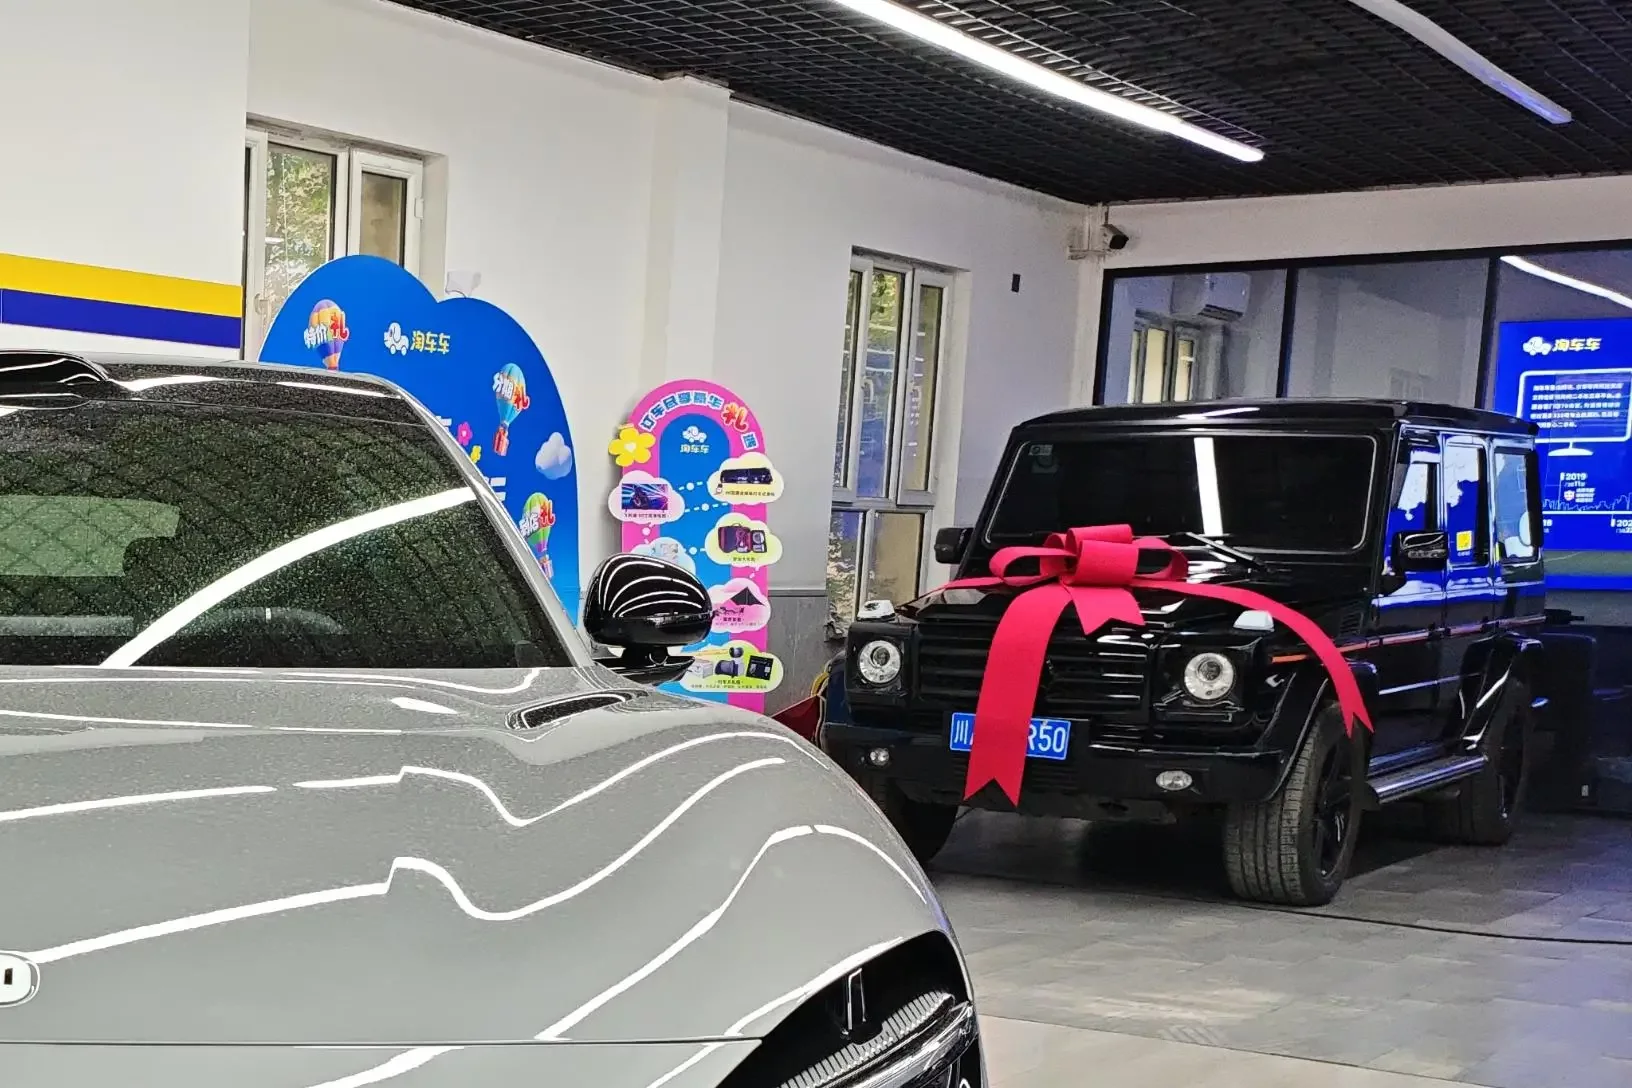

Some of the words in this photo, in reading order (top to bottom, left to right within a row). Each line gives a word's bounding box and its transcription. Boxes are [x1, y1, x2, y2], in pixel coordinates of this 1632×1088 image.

[410, 330, 451, 355] 淘车车
[1552, 336, 1602, 352] 淘车车
[1616, 519, 1632, 528] 202
[953, 719, 1066, 754] 川R50
